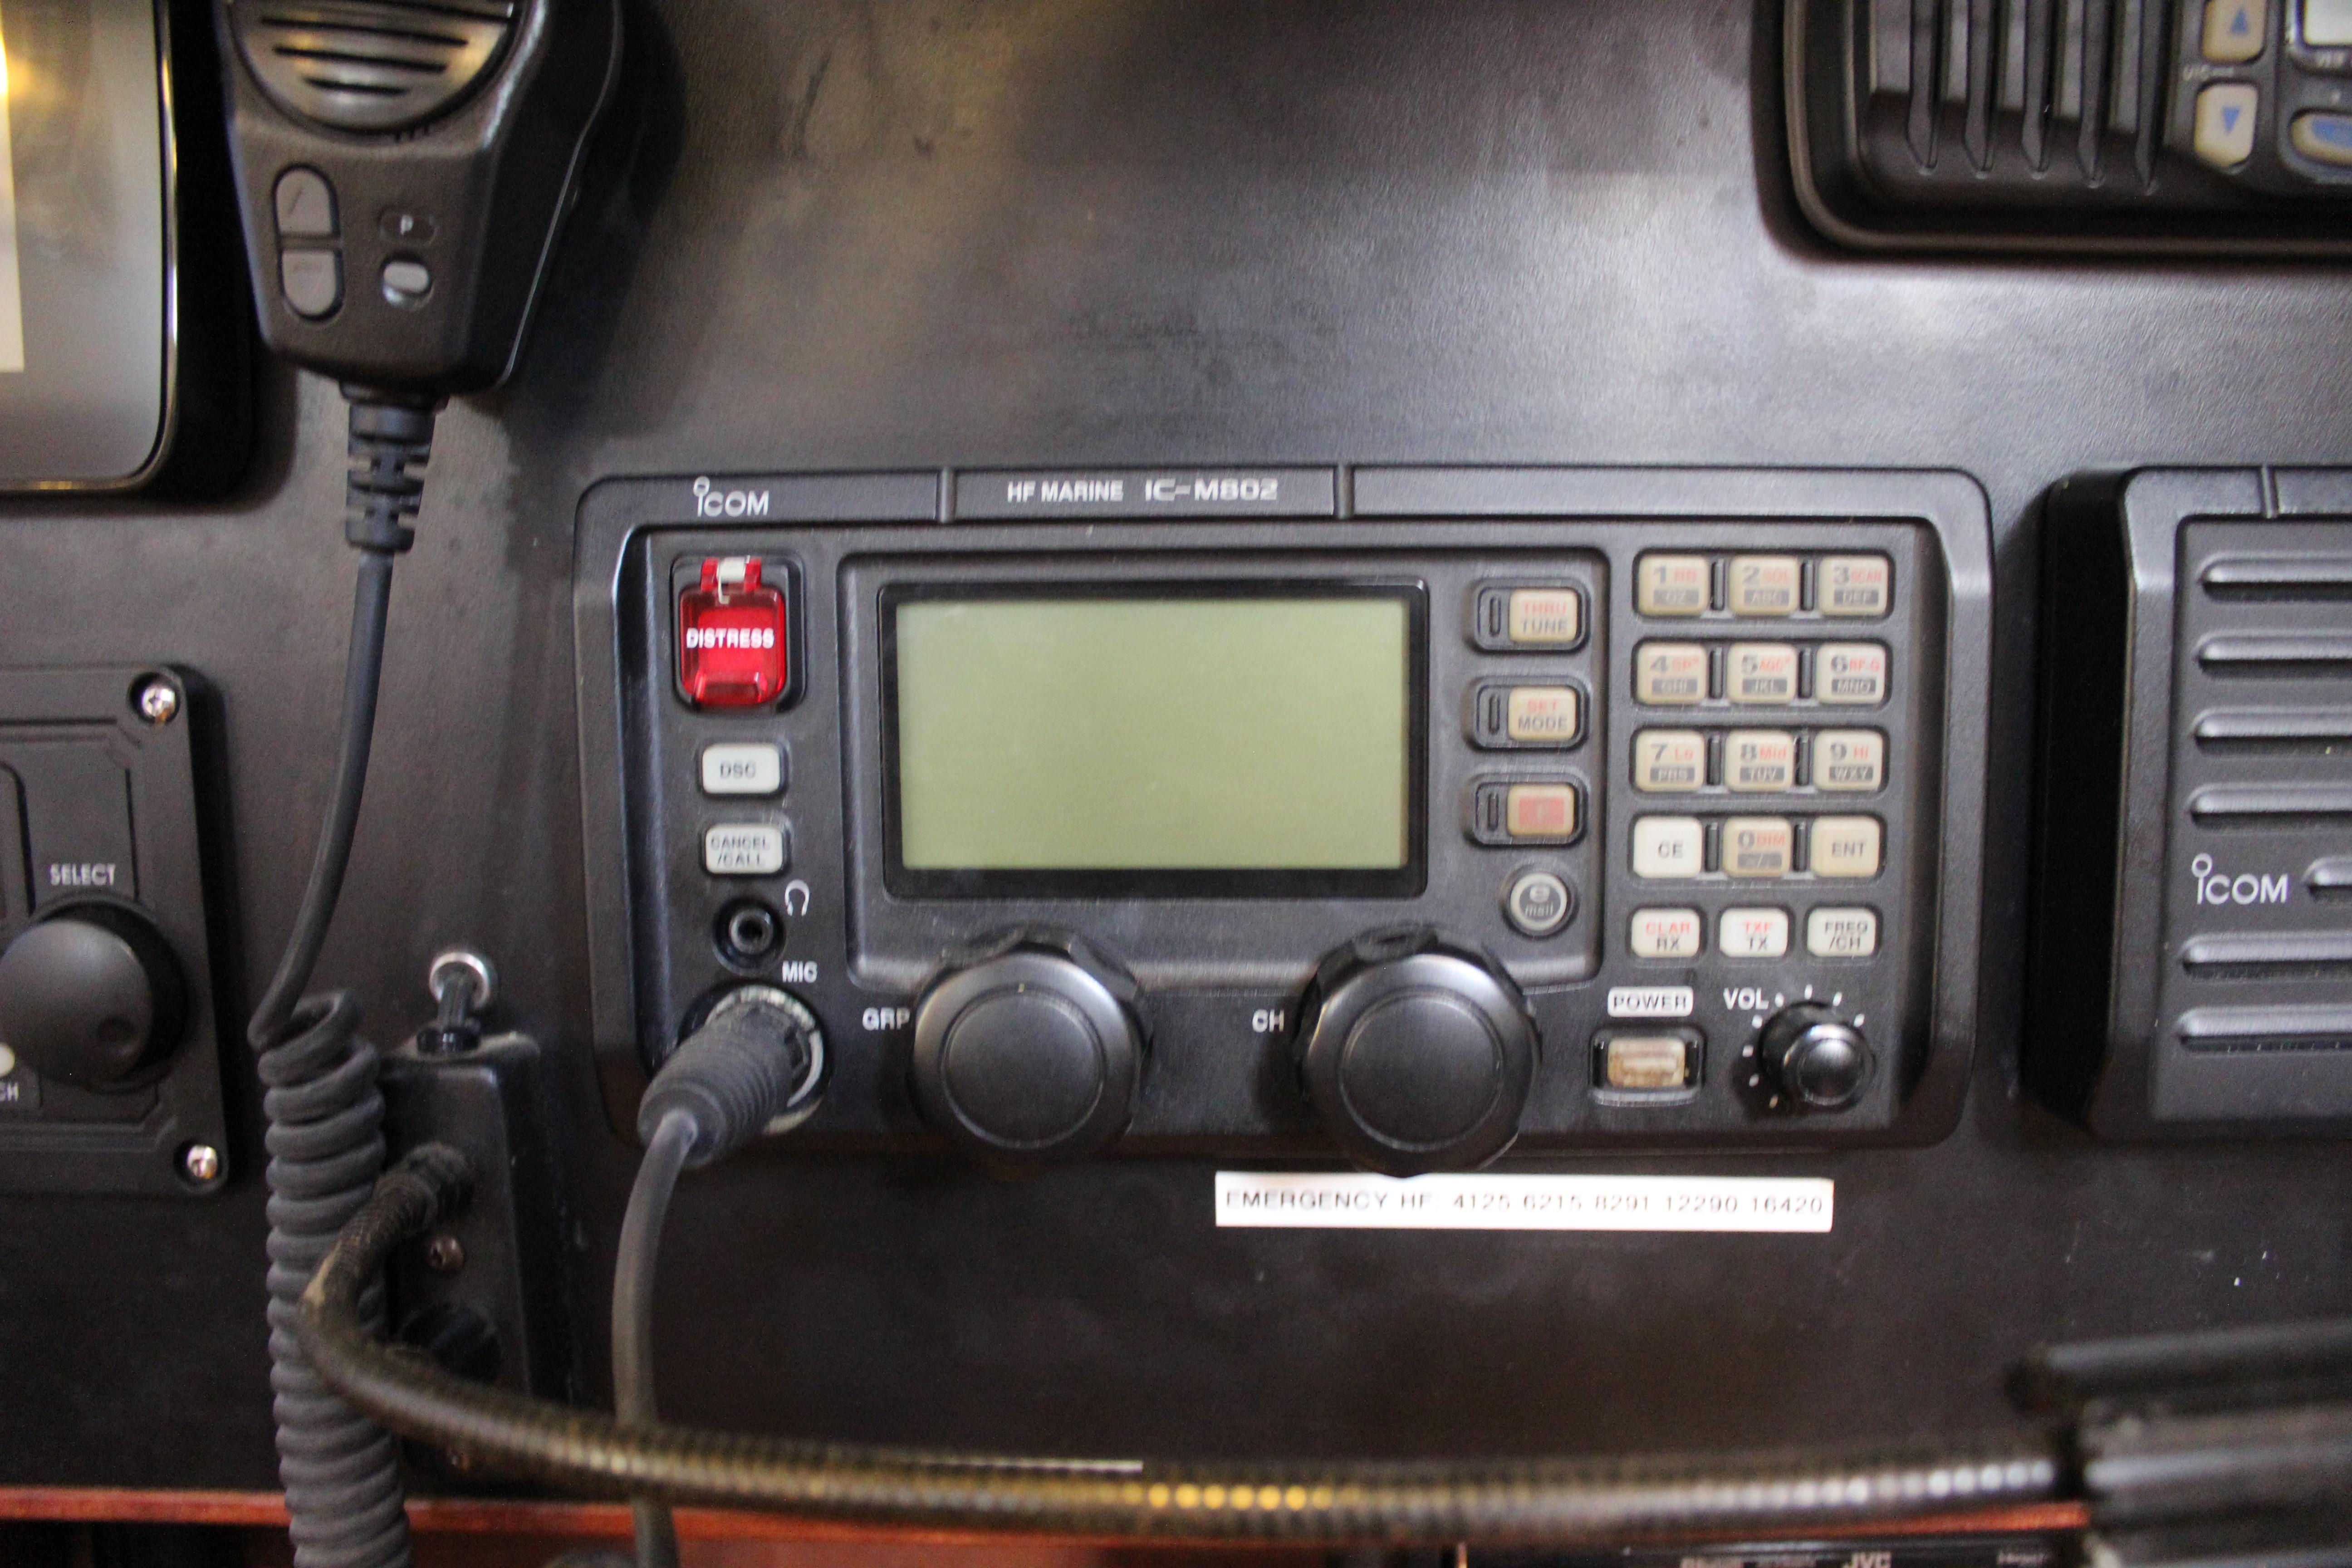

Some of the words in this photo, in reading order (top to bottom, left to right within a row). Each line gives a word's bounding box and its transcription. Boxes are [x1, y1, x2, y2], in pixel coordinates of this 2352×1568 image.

[1007, 481, 1036, 503] HF
[1040, 479, 1123, 502] MARINE
[1145, 478, 1278, 501] IC-M802
[1653, 565, 1666, 584] 1
[1743, 565, 1761, 584] 2
[1833, 566, 1850, 585] 3
[1523, 601, 1568, 616] THRU
[1520, 617, 1567, 633] TUNE
[686, 628, 774, 648] DISTRESS
[1650, 655, 1667, 673] 4
[1741, 655, 1758, 674] 5
[1831, 656, 1848, 674] 6
[1518, 716, 1567, 731] MODE
[1651, 743, 1668, 762] 7
[1740, 744, 1757, 761] 8
[1830, 743, 1847, 762] 9
[720, 761, 756, 779] DSC
[710, 837, 769, 851] CANCEL
[1657, 842, 1684, 860] CE
[1832, 842, 1865, 858] ENT
[49, 862, 116, 885] SELECT
[1646, 922, 1690, 935] CLAR
[1825, 922, 1869, 936] FREQ
[1656, 936, 1680, 952] RX
[1747, 936, 1769, 951] TX
[782, 961, 817, 983] MIC
[1612, 994, 1689, 1010] POWER
[1724, 988, 1769, 1010] VOL
[862, 1008, 910, 1030] GRP
[1252, 1009, 1285, 1033] CH
[1226, 1191, 1388, 1209] EMERGENCY
[1453, 1193, 1510, 1210] 4125
[1523, 1194, 1582, 1211] 6215
[1595, 1195, 1650, 1211] 8291
[1665, 1196, 1738, 1213] 12290
[1752, 1196, 1823, 1214] 16420
